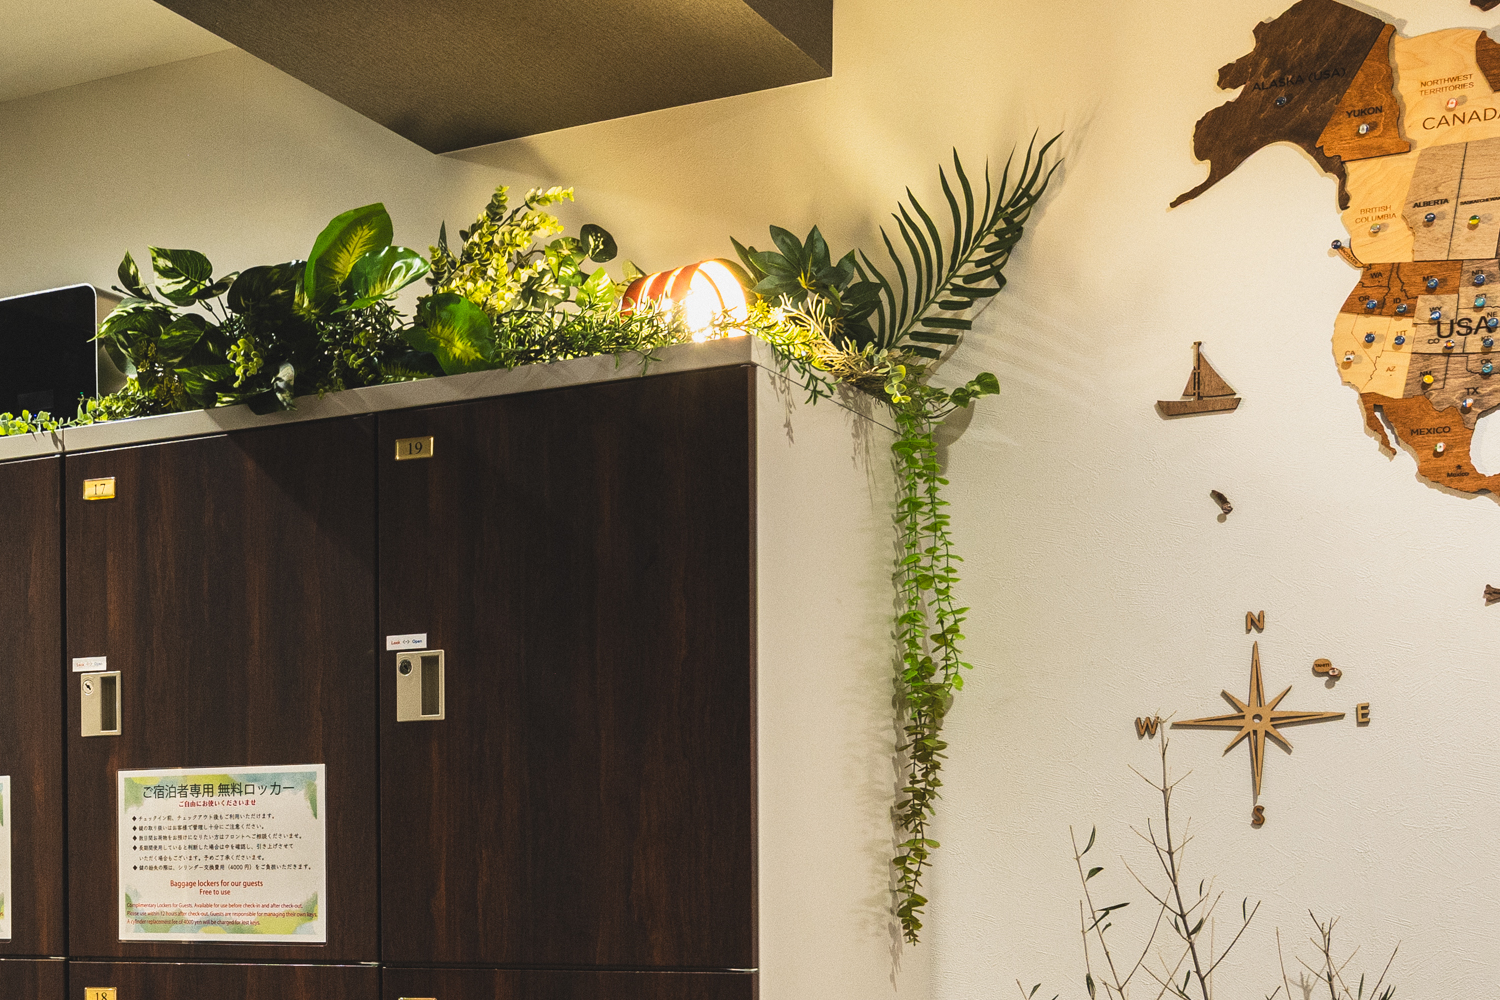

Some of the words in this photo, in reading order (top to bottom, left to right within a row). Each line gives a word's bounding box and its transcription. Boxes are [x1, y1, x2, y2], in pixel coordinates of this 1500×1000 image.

[1252, 75, 1304, 92] ALASKA
[1308, 68, 1346, 84] (USA)
[1420, 74, 1473, 88] NORTHWEST
[1420, 82, 1474, 96] TERRITORIES
[1346, 106, 1383, 118] YUKON
[1360, 205, 1392, 214] BRITISH
[1413, 198, 1449, 208] ALBERTA
[1355, 213, 1396, 224] COLUMBIA
[1436, 316, 1493, 338] USA
[1464, 387, 1480, 395] TX
[1410, 426, 1450, 436] MEXICO
[408, 442, 422, 455] 19
[94, 483, 106, 496] 17
[1246, 610, 1264, 632] N
[1357, 703, 1370, 724] E
[1136, 716, 1160, 736] W
[143, 784, 214, 798] ご宿泊者専用
[218, 782, 294, 796] 無料ロッカー
[178, 800, 256, 808] ご自由にお使いくださいませ
[1252, 806, 1265, 826] S
[170, 880, 196, 888] Baggage
